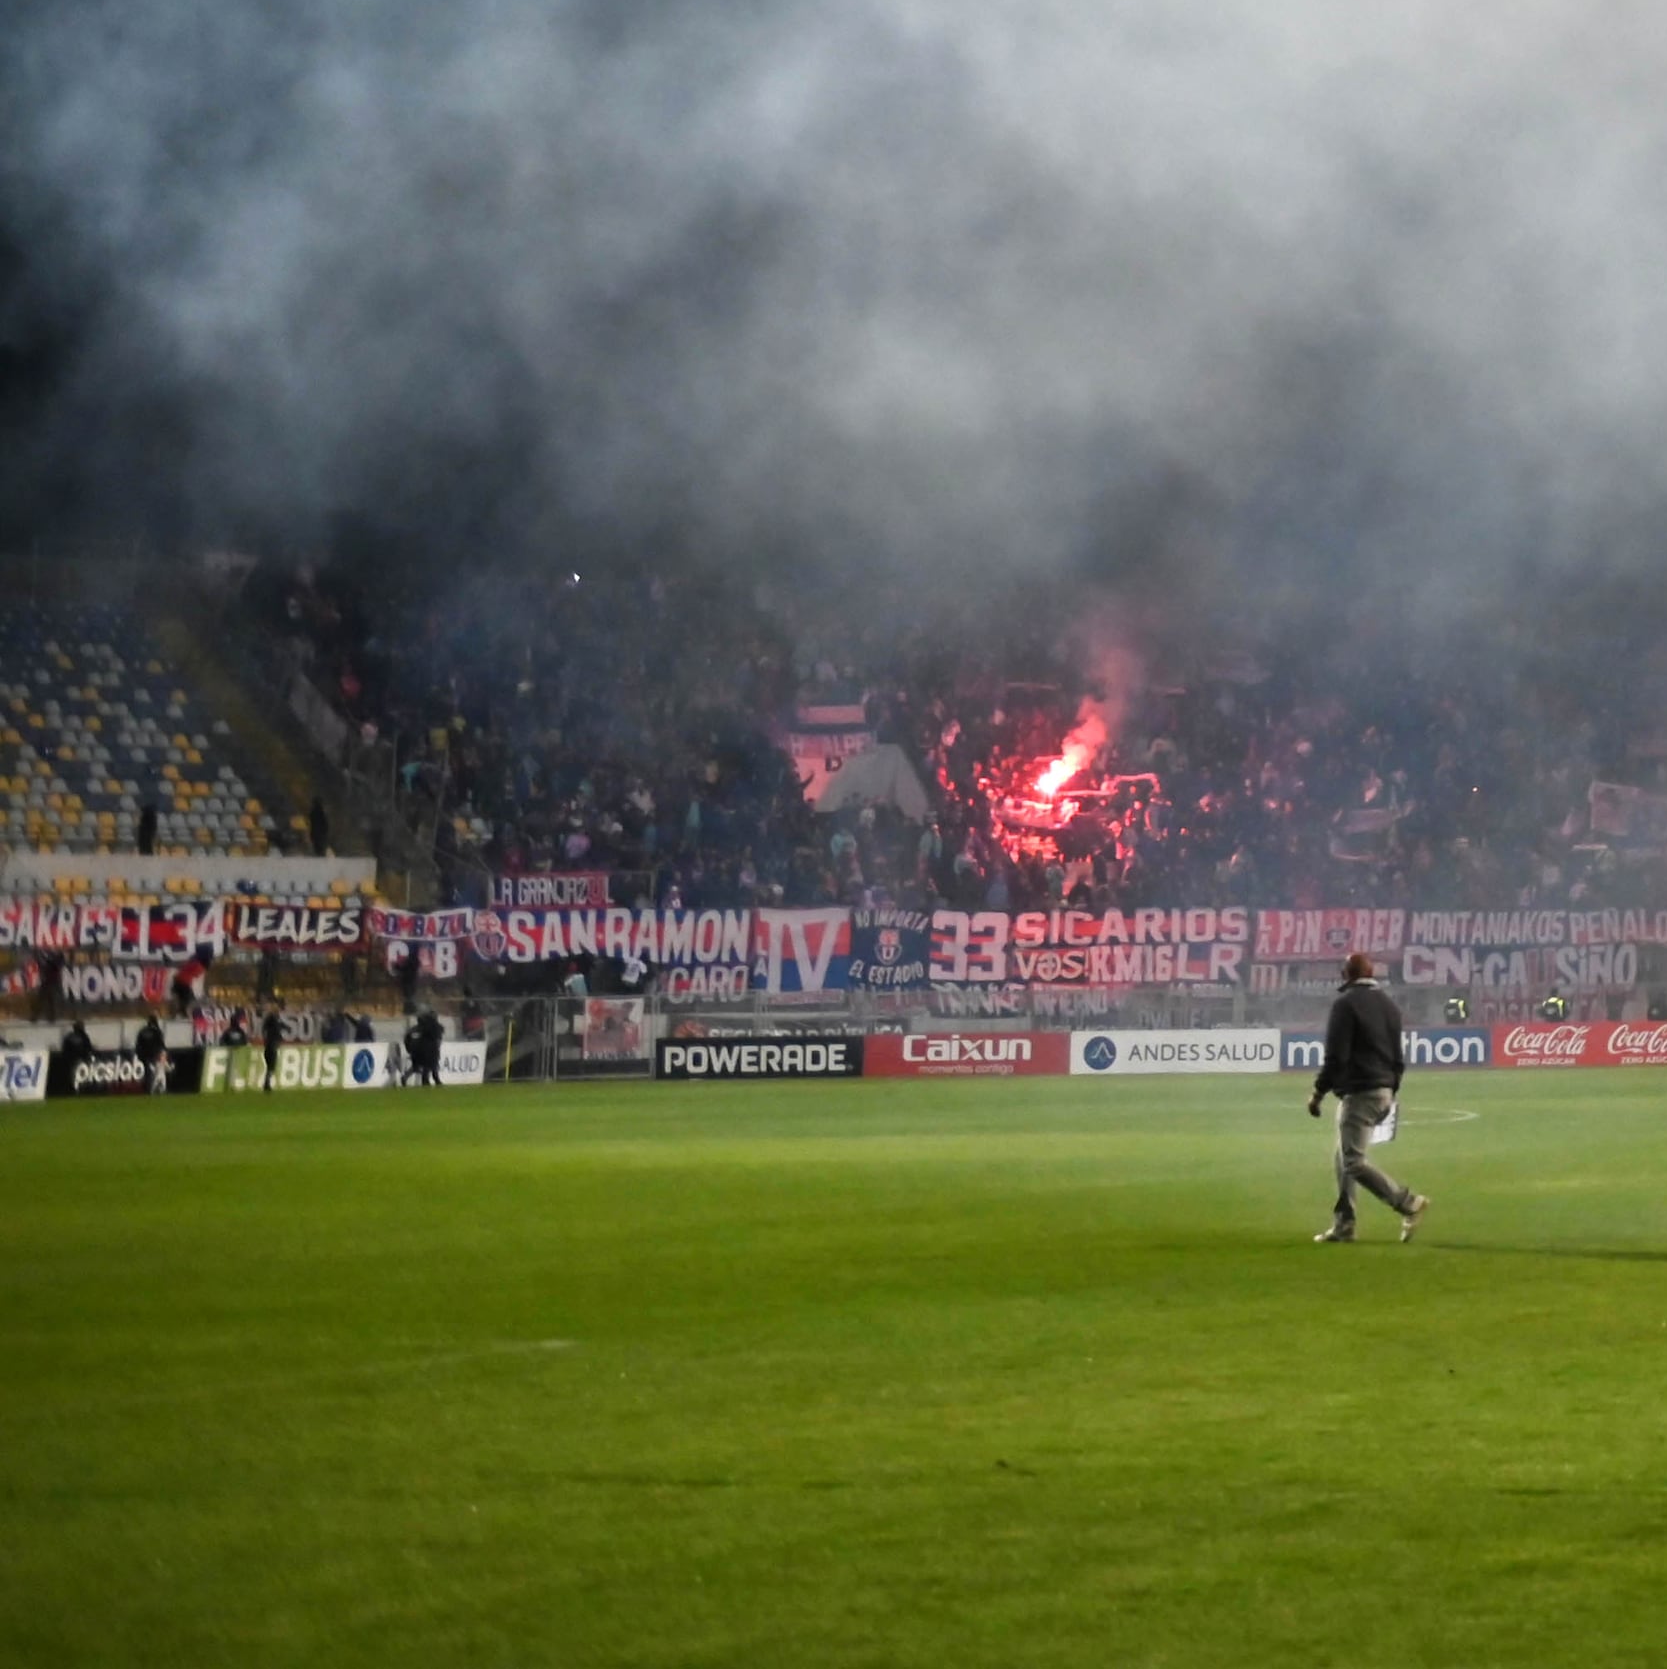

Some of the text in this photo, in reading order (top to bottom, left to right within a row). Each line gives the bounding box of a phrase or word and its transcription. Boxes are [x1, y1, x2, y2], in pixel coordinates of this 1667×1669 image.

[238, 905, 361, 944] LEALES
[507, 907, 750, 965] SAN RAMON
[1015, 906, 1248, 948] SICARIOS
[929, 910, 1009, 981] 33
[667, 965, 750, 1005] CARO
[664, 1044, 848, 1074] POWERADE
[903, 1034, 1032, 1062] Caixun
[1128, 1042, 1275, 1062] ANDES SALUD
[74, 1055, 145, 1091] picslab
